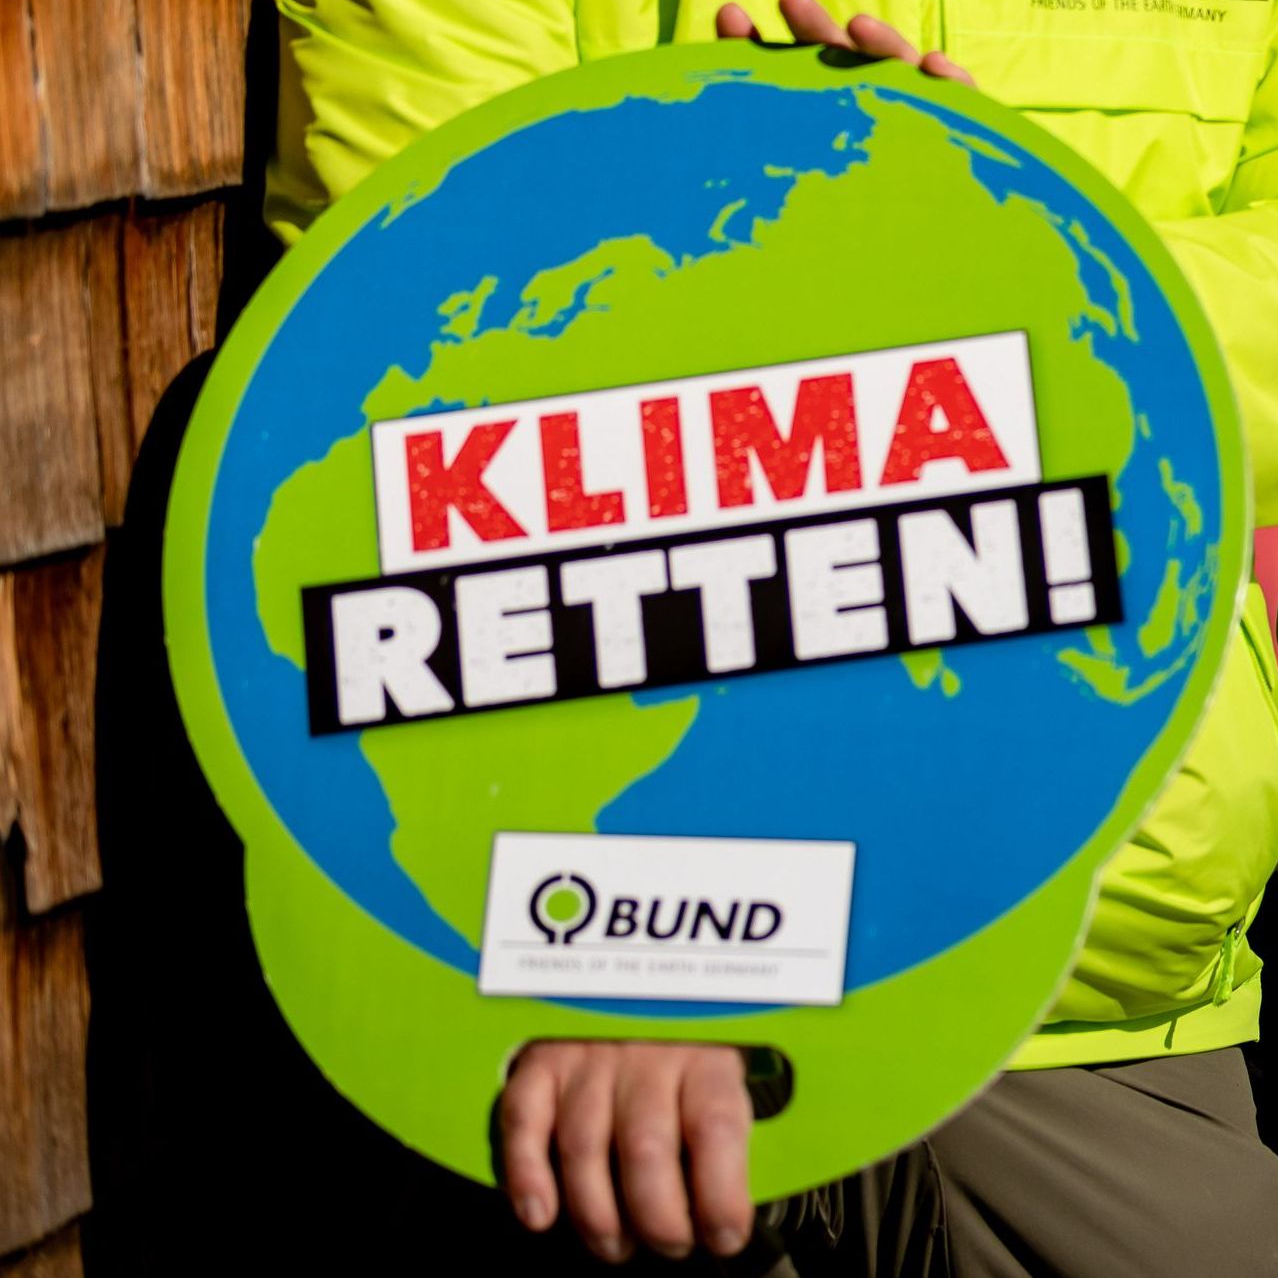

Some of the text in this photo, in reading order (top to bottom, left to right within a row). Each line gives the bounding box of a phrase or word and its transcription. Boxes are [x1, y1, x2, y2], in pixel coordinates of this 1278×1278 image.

[403, 356, 1010, 553] KLIMA
[330, 487, 1098, 726] RETTEN!
[605, 898, 783, 943] BUND
